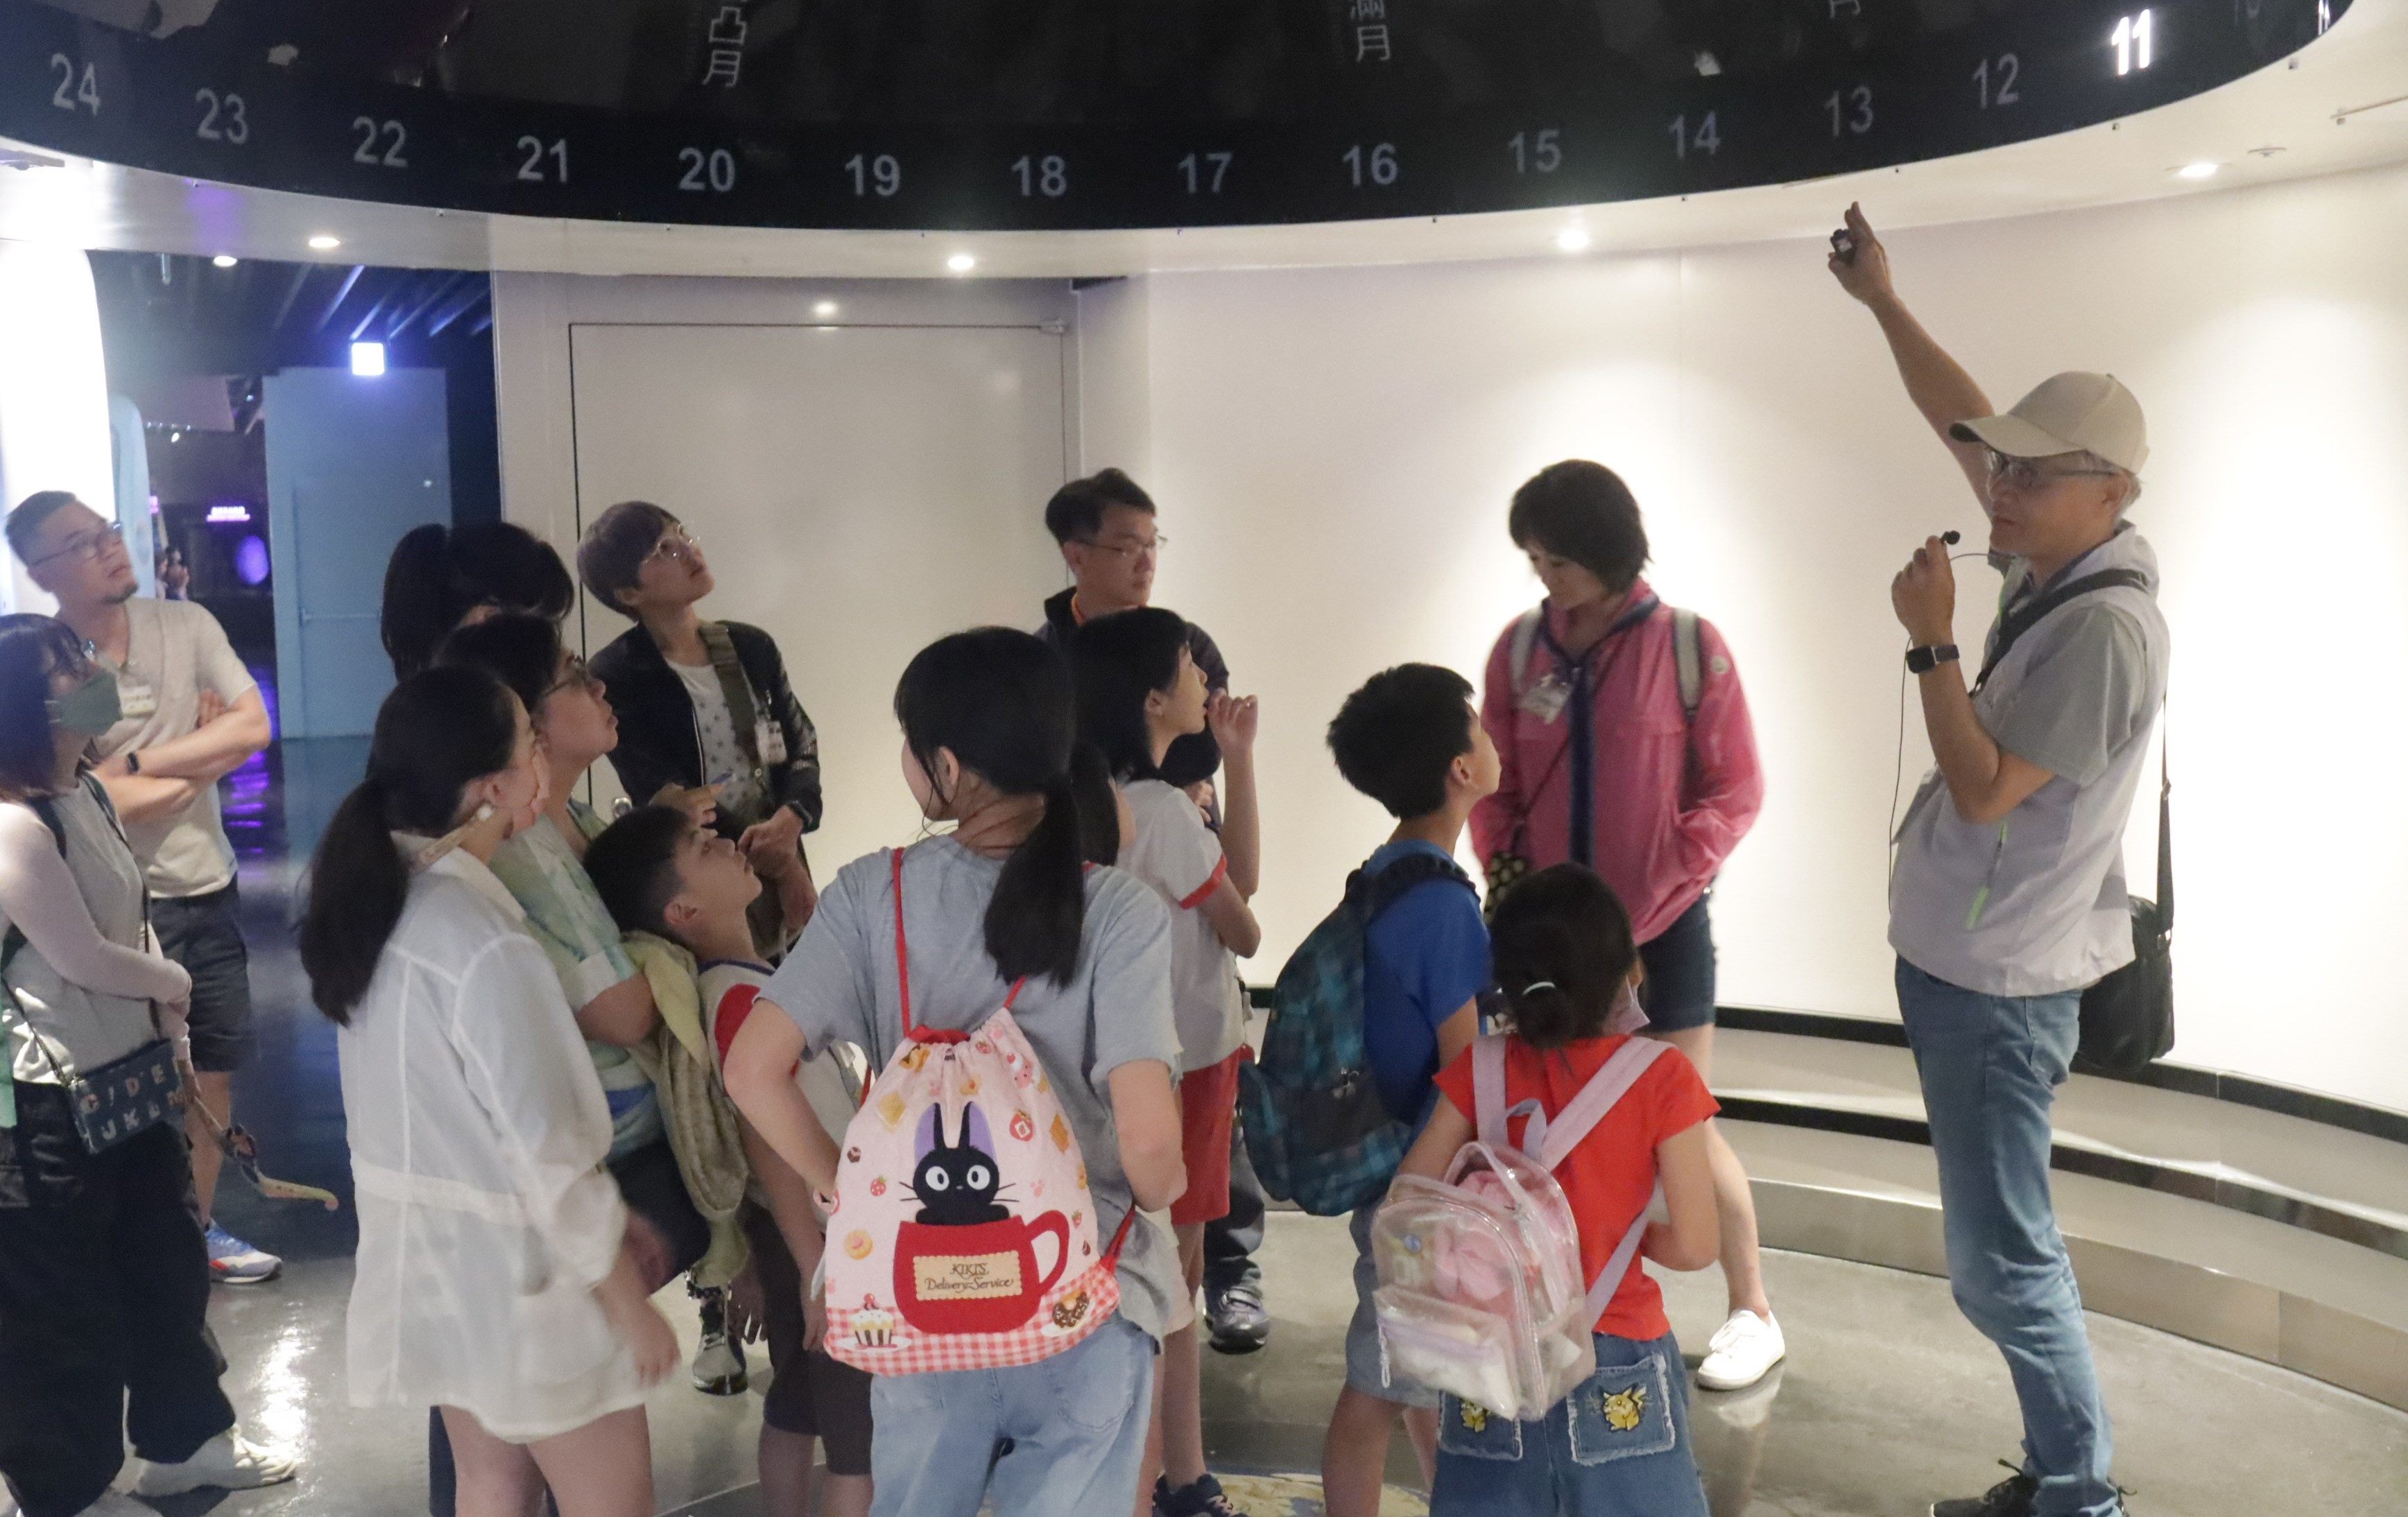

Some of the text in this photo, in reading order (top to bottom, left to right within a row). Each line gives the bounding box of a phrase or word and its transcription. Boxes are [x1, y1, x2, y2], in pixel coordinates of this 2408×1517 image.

[703, 6, 746, 87] 凸月
[51, 9, 2151, 197] 24 23 22 21 20 19 18 17 16 15 14 13 12 11
[970, 1276, 1014, 1290] Service
